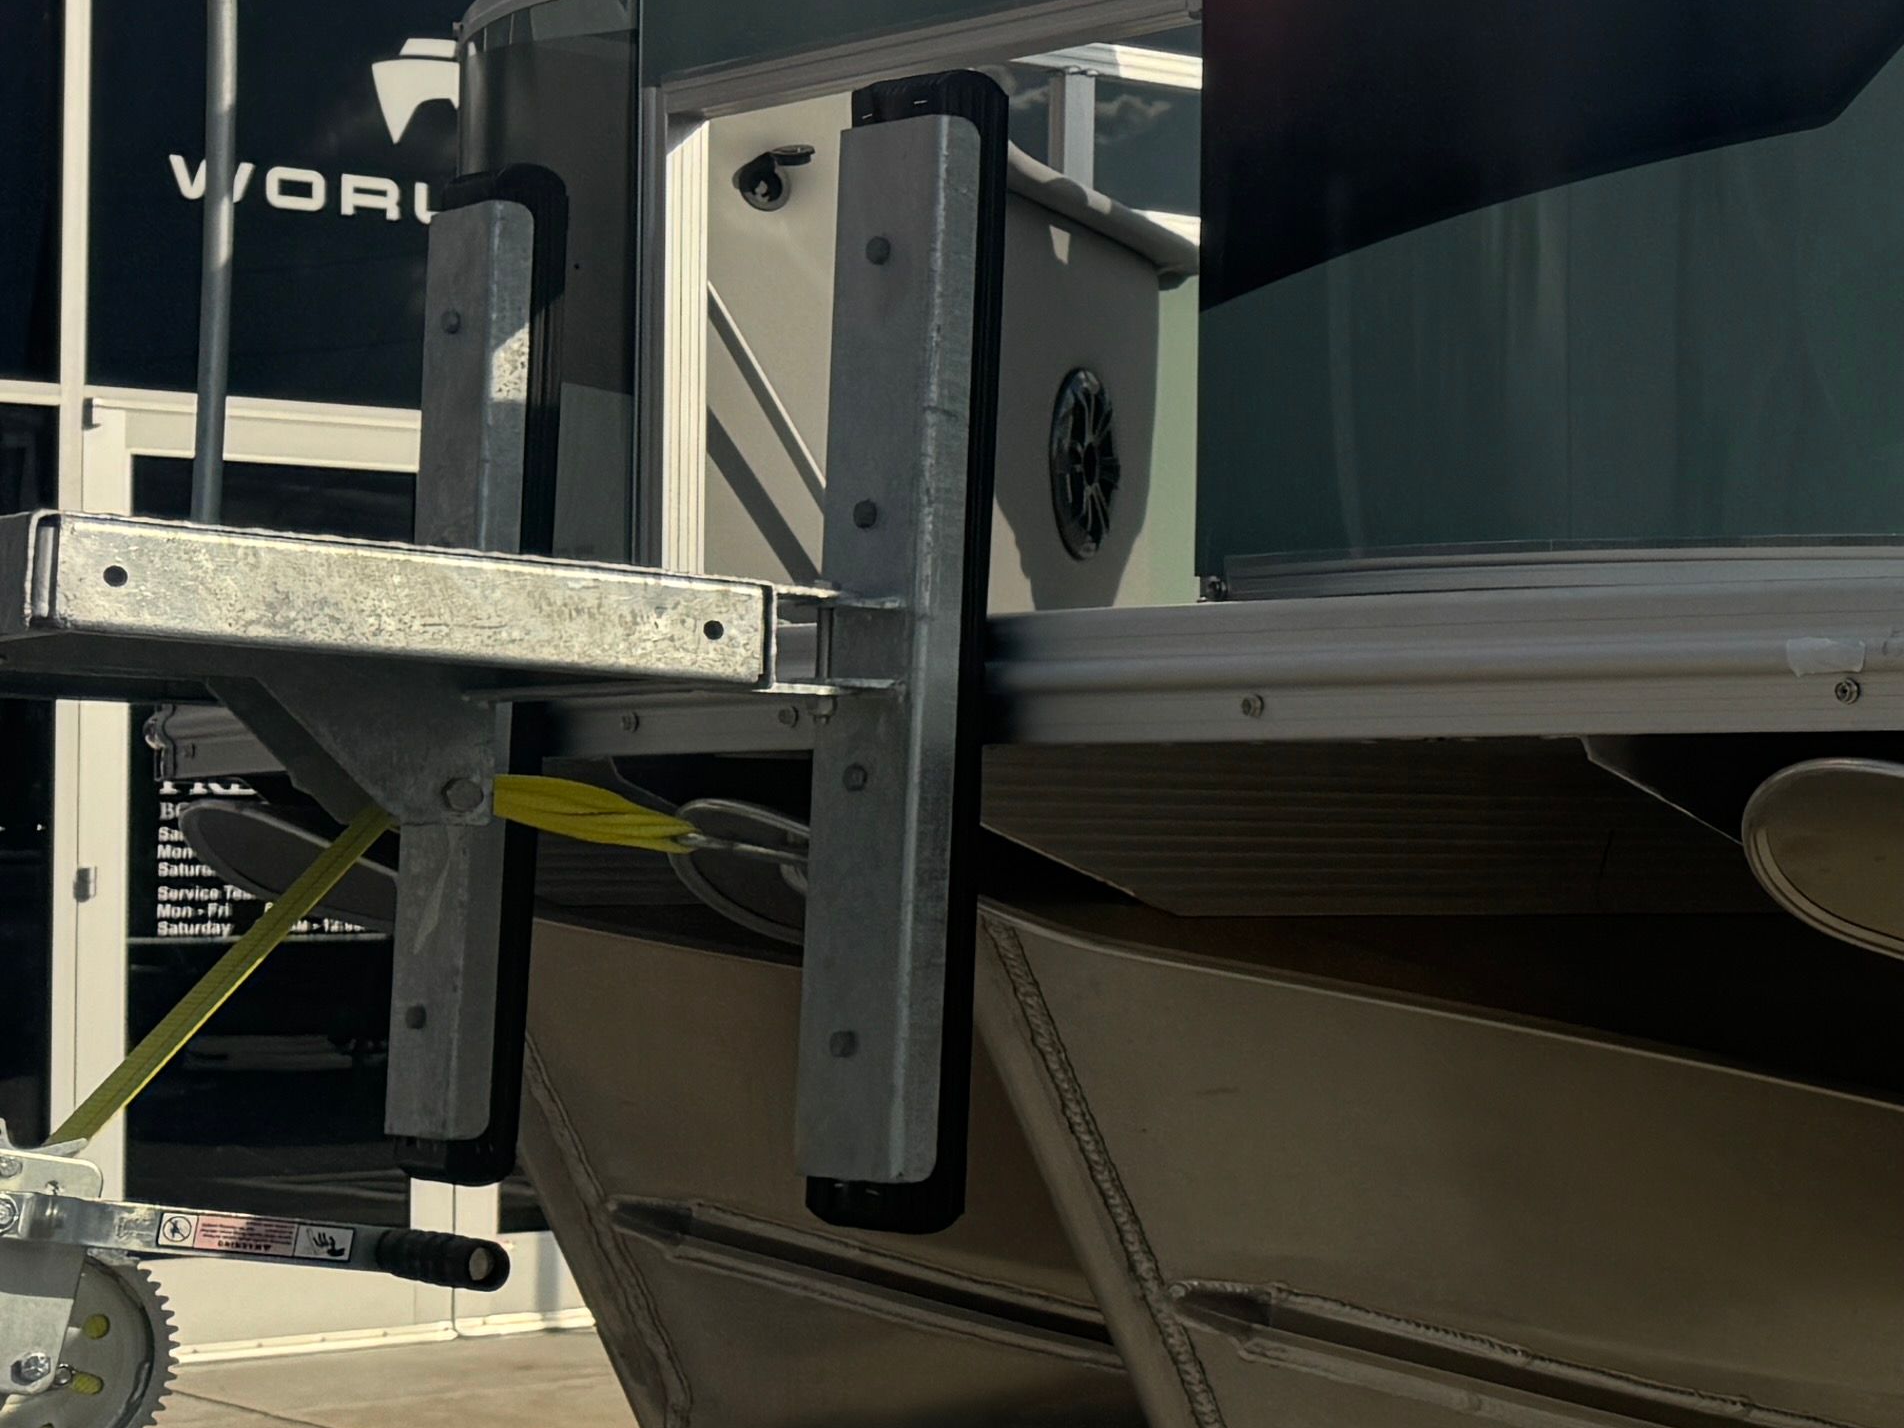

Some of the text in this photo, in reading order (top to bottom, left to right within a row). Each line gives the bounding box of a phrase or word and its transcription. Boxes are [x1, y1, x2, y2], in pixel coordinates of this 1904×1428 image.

[157, 844, 193, 860] Mon
[157, 885, 221, 901] Service
[157, 904, 193, 919] Mon
[207, 902, 232, 919] Fri
[157, 920, 233, 939] Saturday
